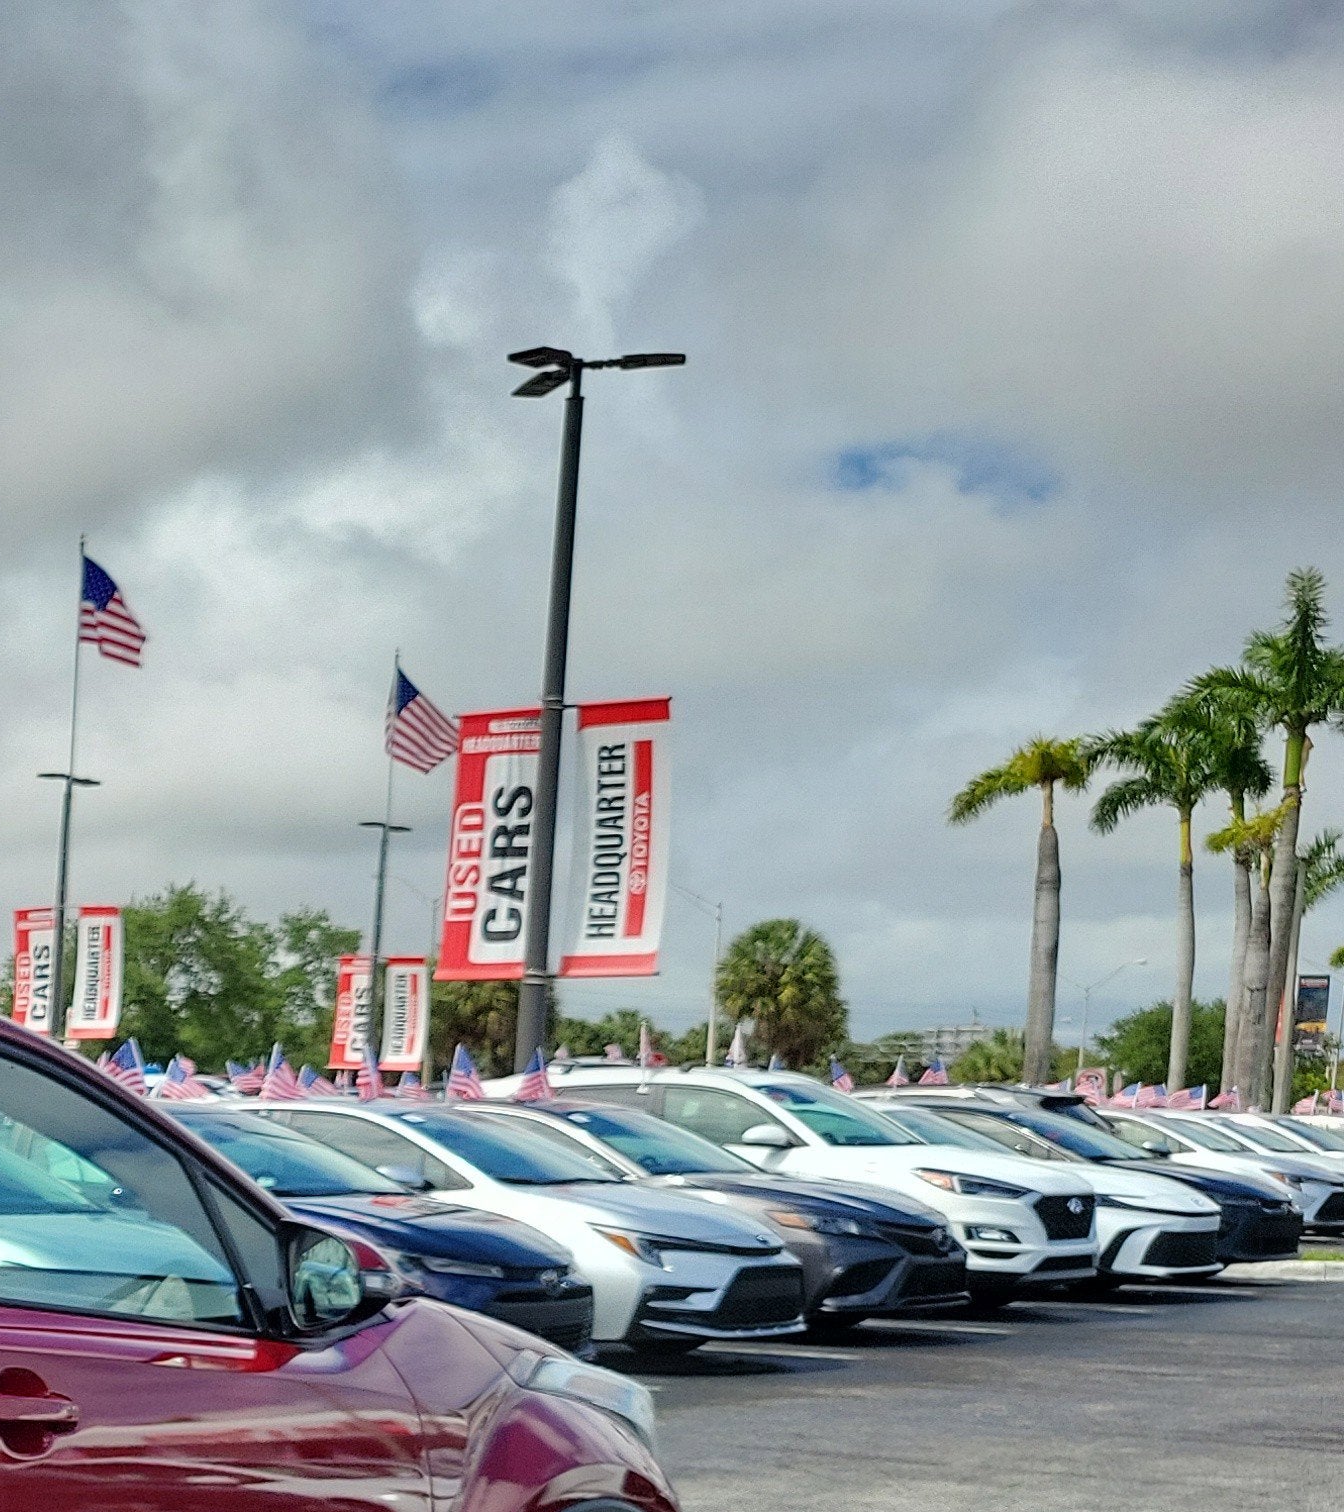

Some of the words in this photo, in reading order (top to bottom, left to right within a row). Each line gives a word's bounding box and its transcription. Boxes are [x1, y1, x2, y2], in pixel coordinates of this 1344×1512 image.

[450, 807, 484, 916] USED
[482, 785, 533, 943] CARS
[586, 742, 627, 939] HEADQUARTER
[631, 792, 651, 874] TOYOTA
[17, 956, 30, 1009] USED
[32, 944, 50, 1020] CARS
